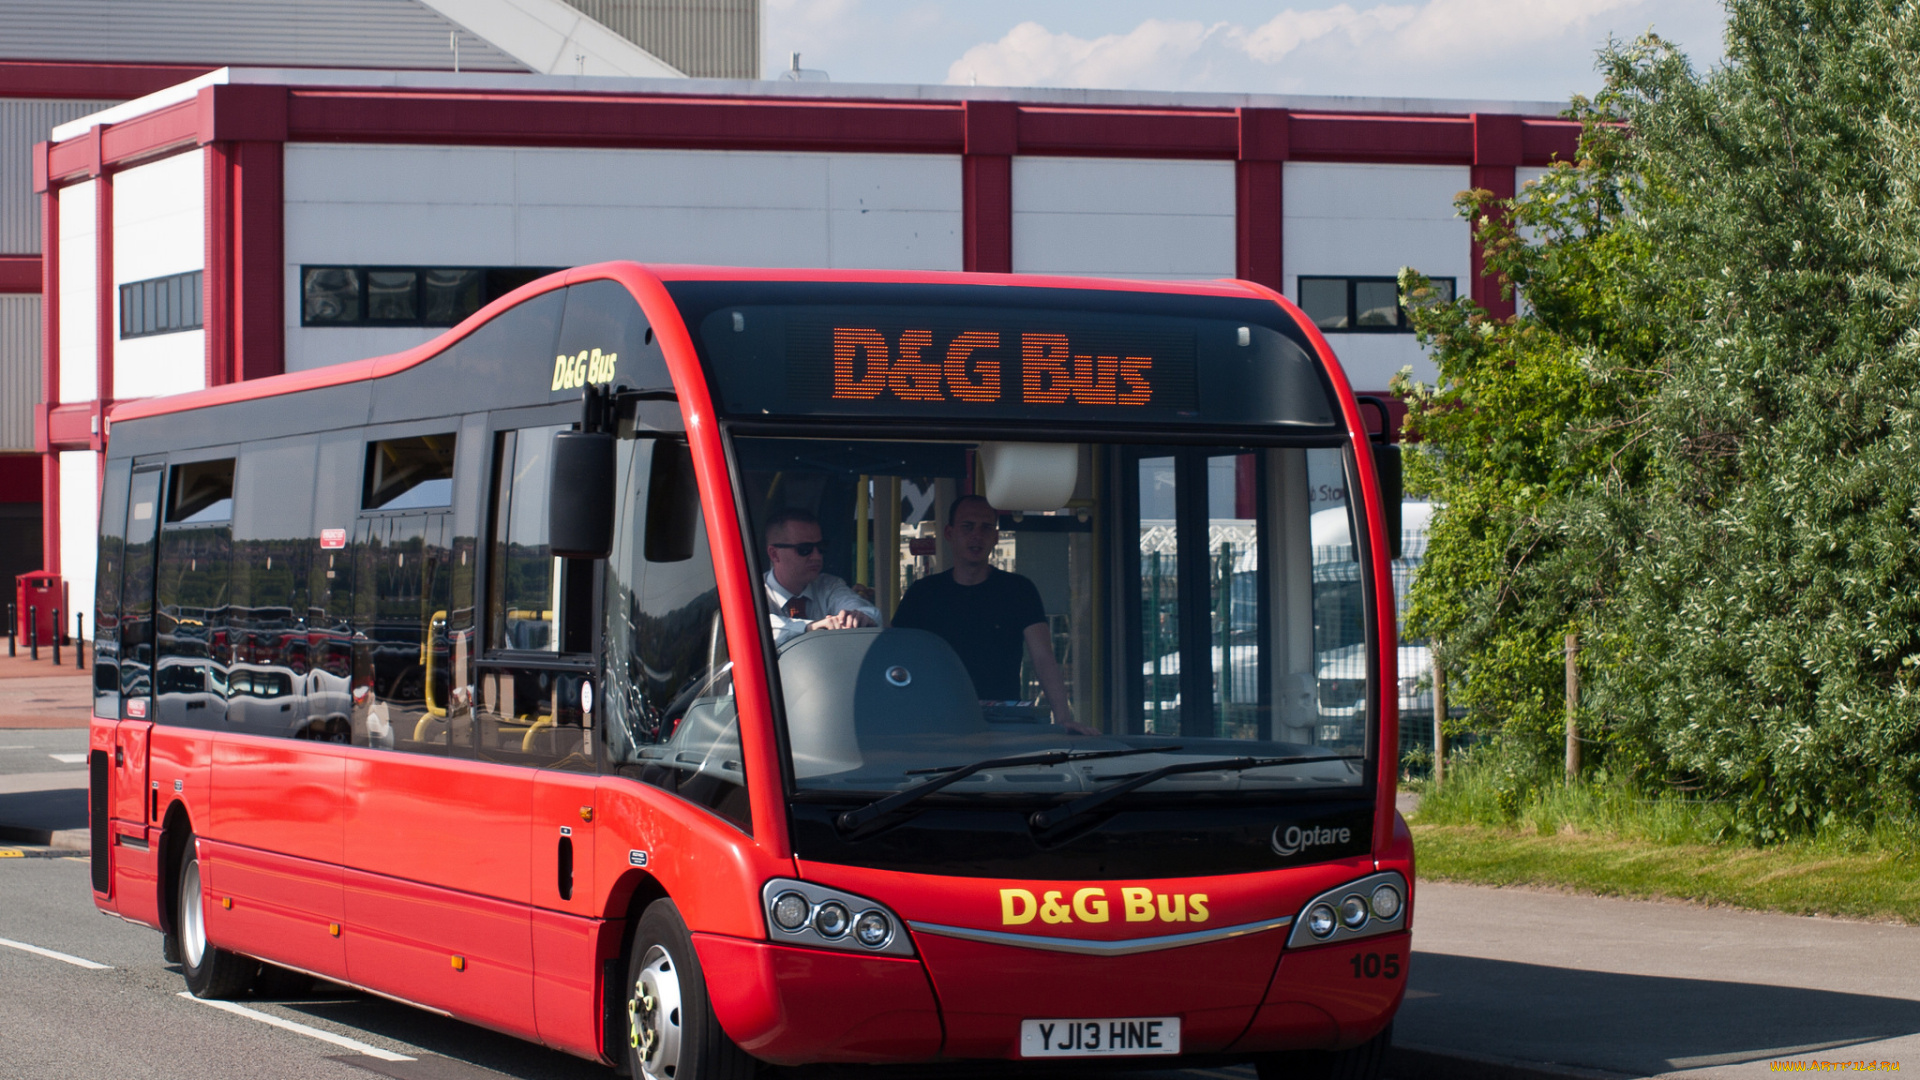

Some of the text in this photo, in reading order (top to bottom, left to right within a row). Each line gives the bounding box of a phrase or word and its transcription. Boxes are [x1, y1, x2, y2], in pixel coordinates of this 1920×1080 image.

[551, 348, 617, 391] D&G Bus
[832, 327, 1153, 406] D&G Bus
[1284, 825, 1351, 852] Optare
[999, 887, 1210, 925] D&G Bus
[1350, 952, 1400, 979] 105
[1039, 1021, 1163, 1050] YJ13 HNE
